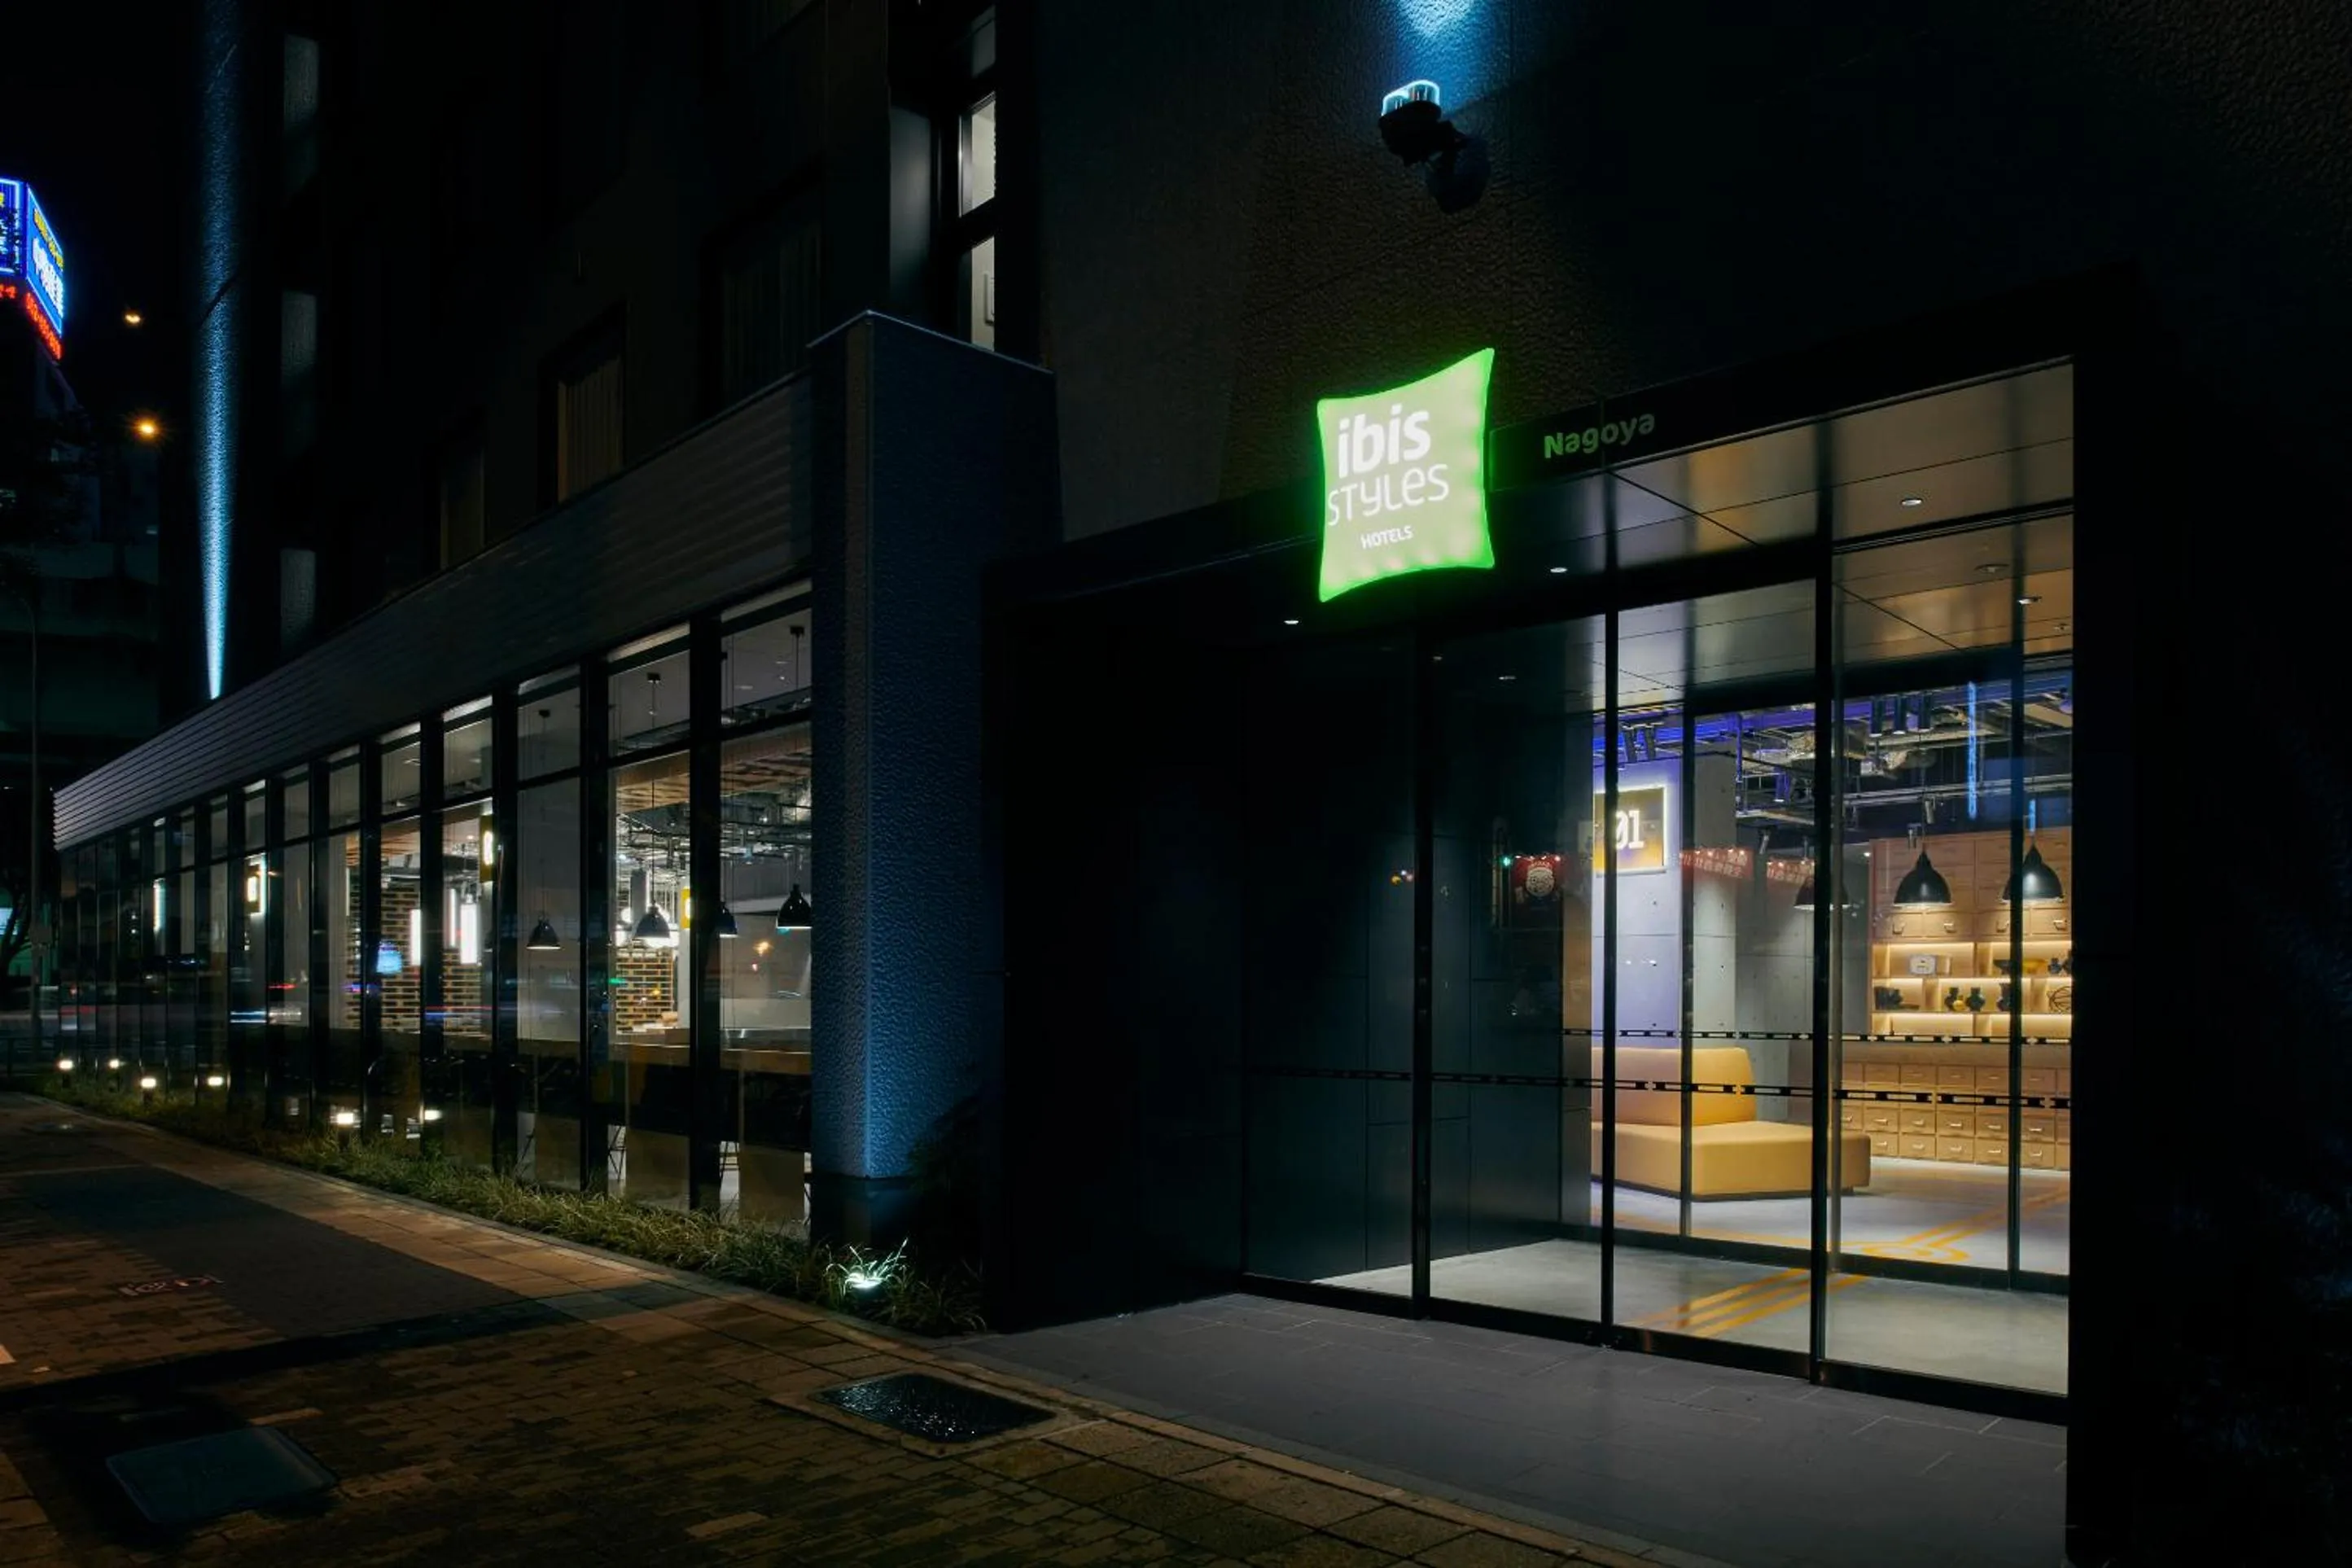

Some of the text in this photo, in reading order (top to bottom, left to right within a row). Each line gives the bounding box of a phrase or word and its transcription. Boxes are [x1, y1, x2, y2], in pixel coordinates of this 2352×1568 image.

[1338, 404, 1431, 479] ibis
[1544, 414, 1655, 458] Nagoya
[1360, 525, 1414, 550] HOTELS
